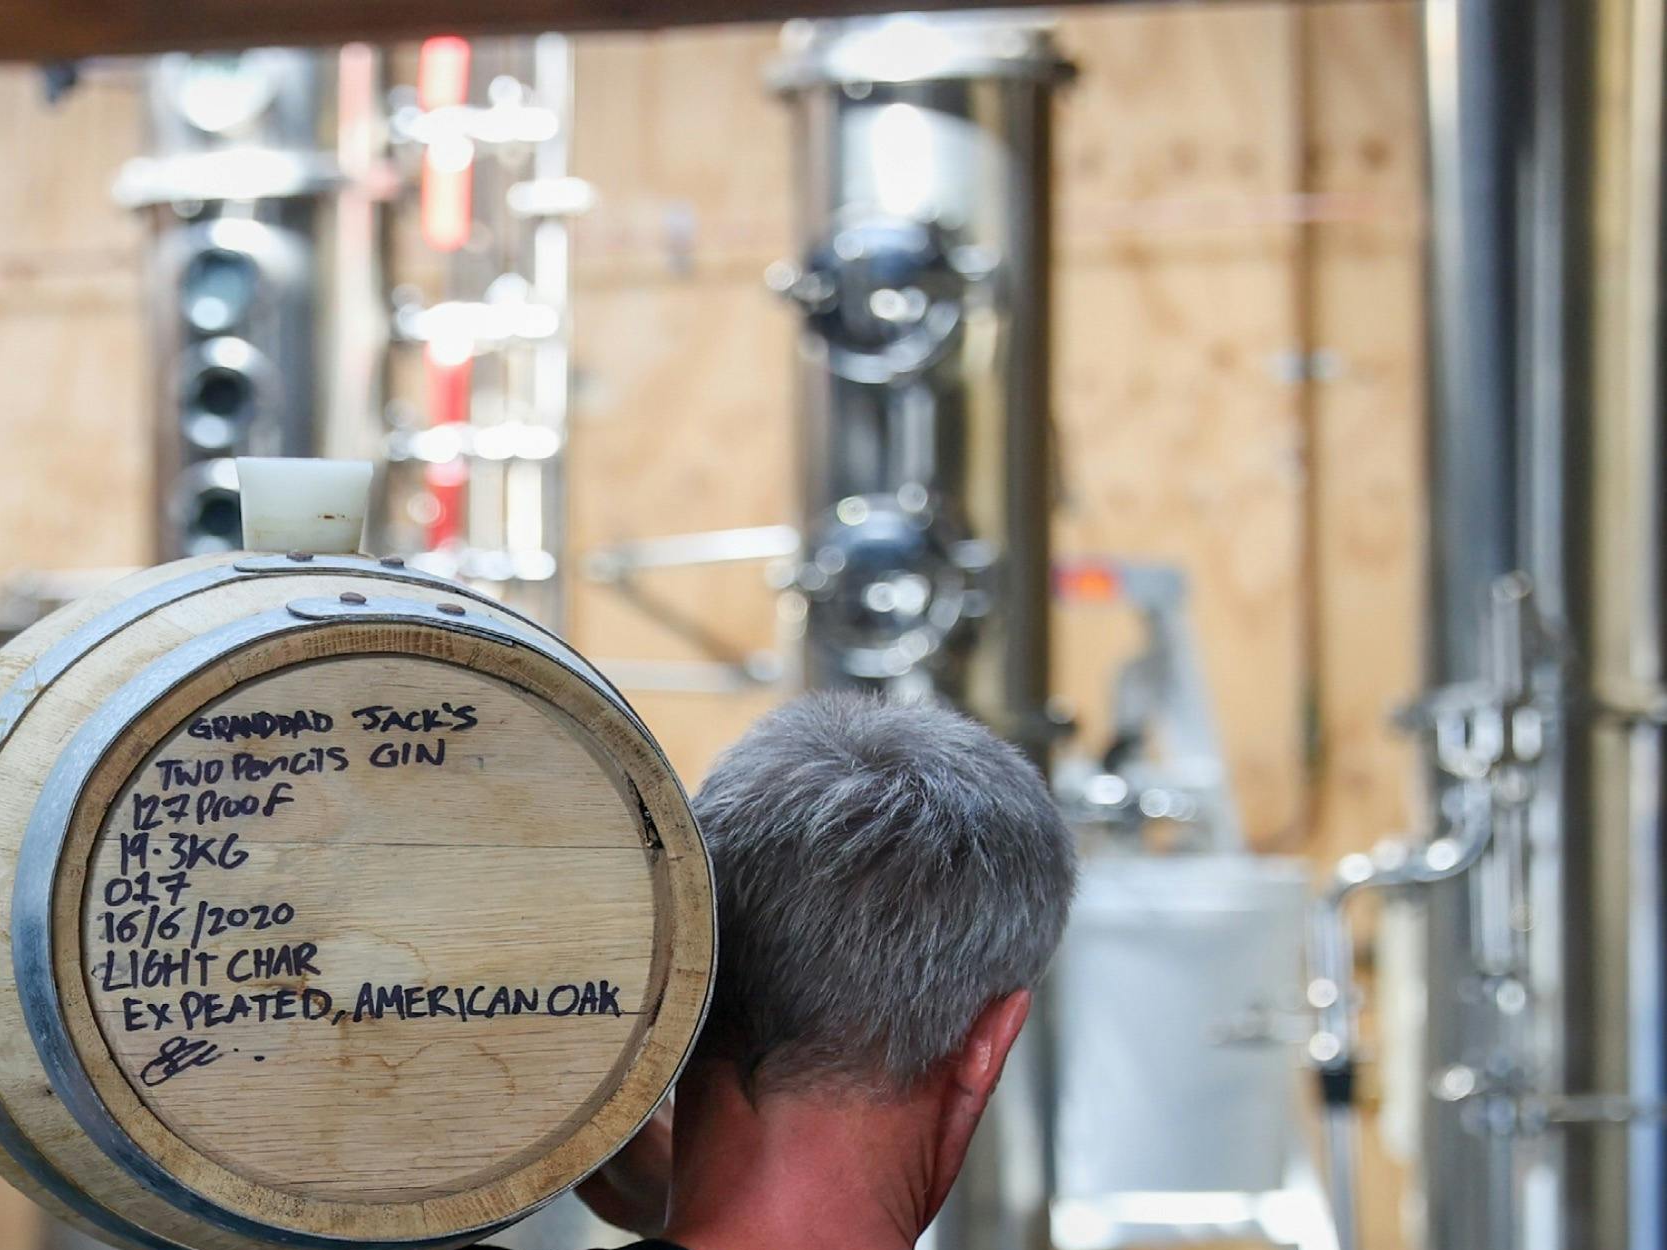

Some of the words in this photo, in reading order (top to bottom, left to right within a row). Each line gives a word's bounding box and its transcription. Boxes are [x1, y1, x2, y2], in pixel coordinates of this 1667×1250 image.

[352, 703, 478, 732] JACK'S
[156, 760, 224, 791] TWO
[369, 739, 445, 767] GIN
[134, 794, 190, 830] 127
[120, 833, 249, 876] 19.3KG
[105, 872, 191, 906] 017
[105, 901, 294, 949] 16/6/2020
[102, 948, 218, 991] LIGHT
[227, 942, 321, 982] CHAR
[180, 988, 345, 1030] PEATED,
[353, 982, 538, 1022] AMERICAN
[547, 980, 621, 1017] OAK
